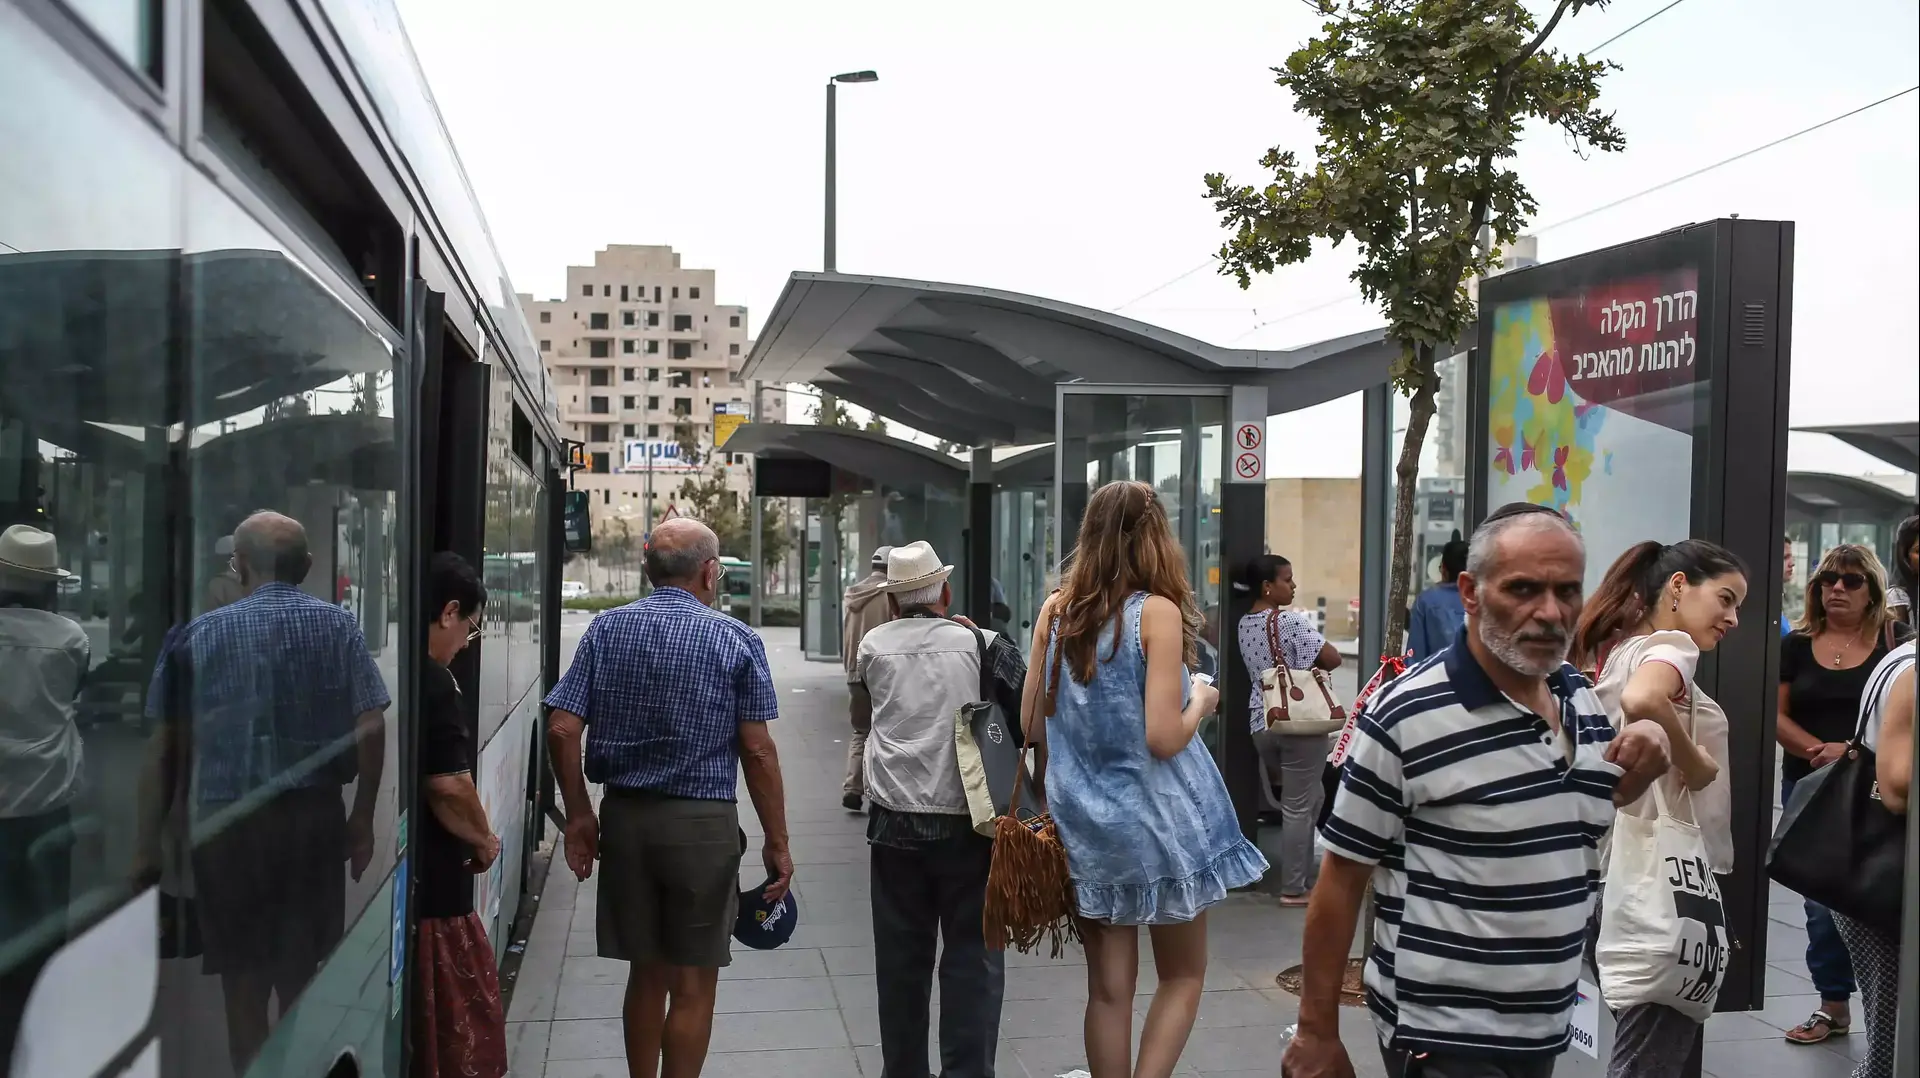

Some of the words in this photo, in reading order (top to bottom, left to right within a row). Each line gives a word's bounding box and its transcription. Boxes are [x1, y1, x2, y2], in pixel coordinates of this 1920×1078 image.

[1600, 299, 1646, 338] הקלה
[1652, 290, 1697, 332] הדרך
[1572, 346, 1633, 380] מהאביב
[1638, 331, 1696, 372] ליהנות
[1678, 938, 1730, 973] LOVE
